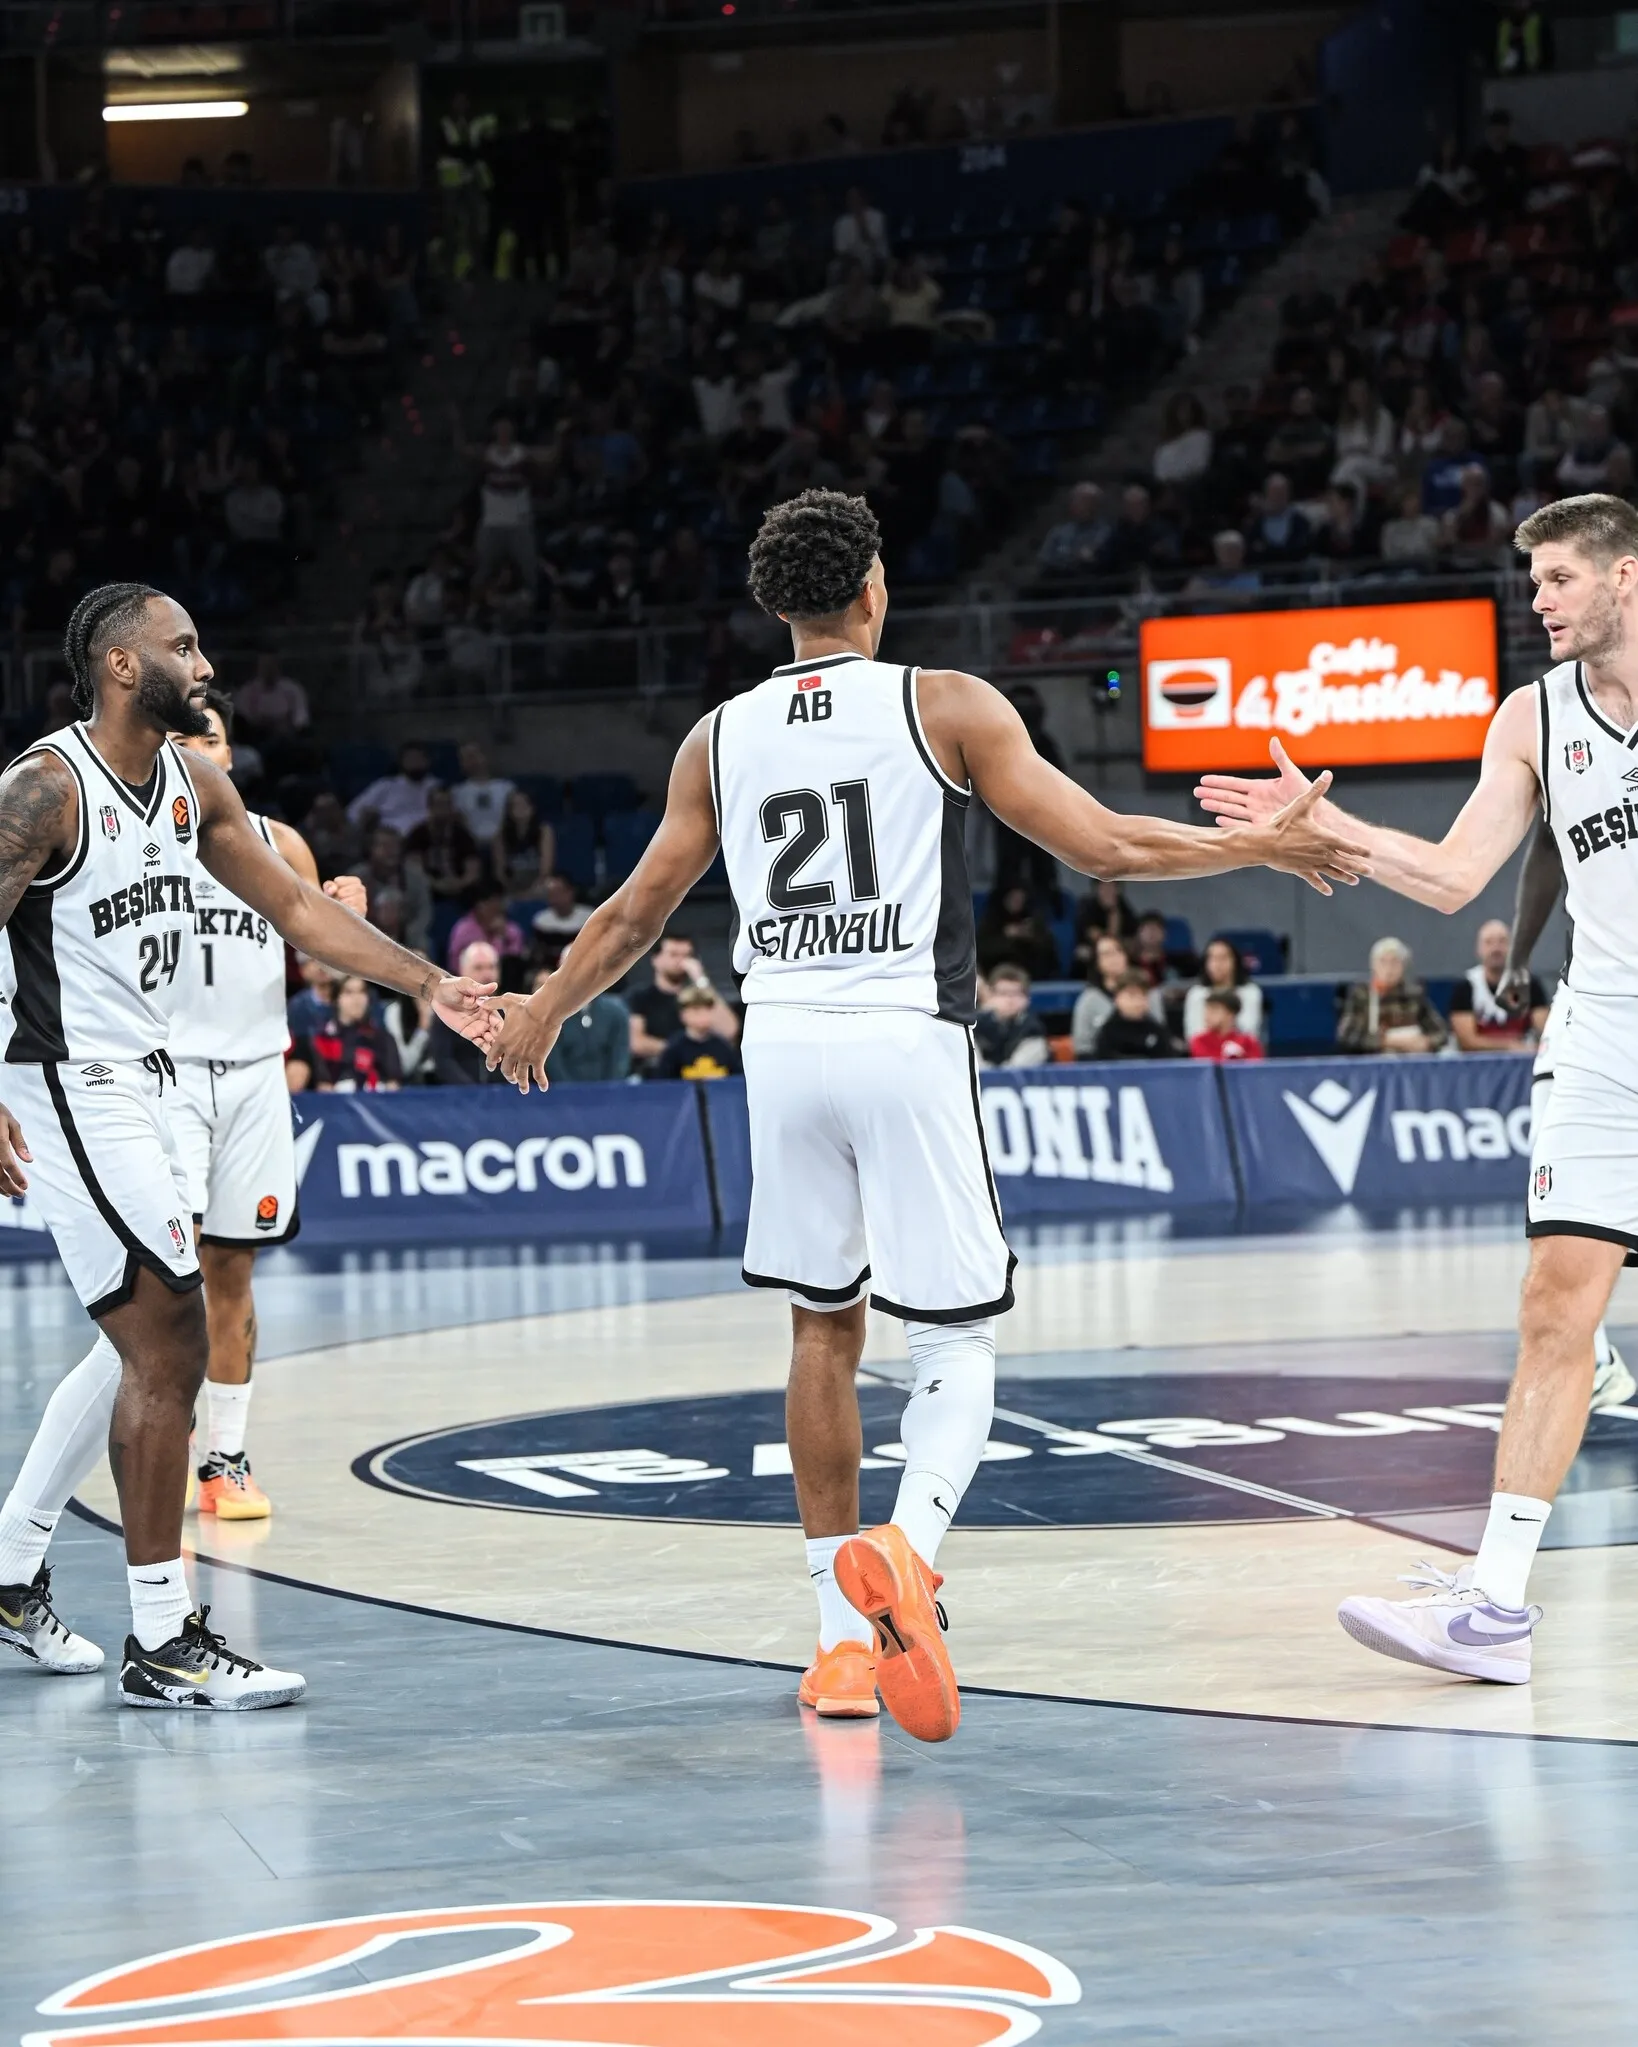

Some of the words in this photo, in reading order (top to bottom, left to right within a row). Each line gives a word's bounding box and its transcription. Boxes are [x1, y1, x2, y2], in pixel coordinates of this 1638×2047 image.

[786, 689, 833, 725] AB
[759, 778, 880, 911] 21
[1567, 797, 1638, 864] BEŞİ
[139, 929, 182, 994] 24
[200, 942, 214, 986] 1
[86, 1078, 115, 1087] umbro
[337, 1134, 647, 1198] macron
[981, 1086, 1174, 1193] ONIA
